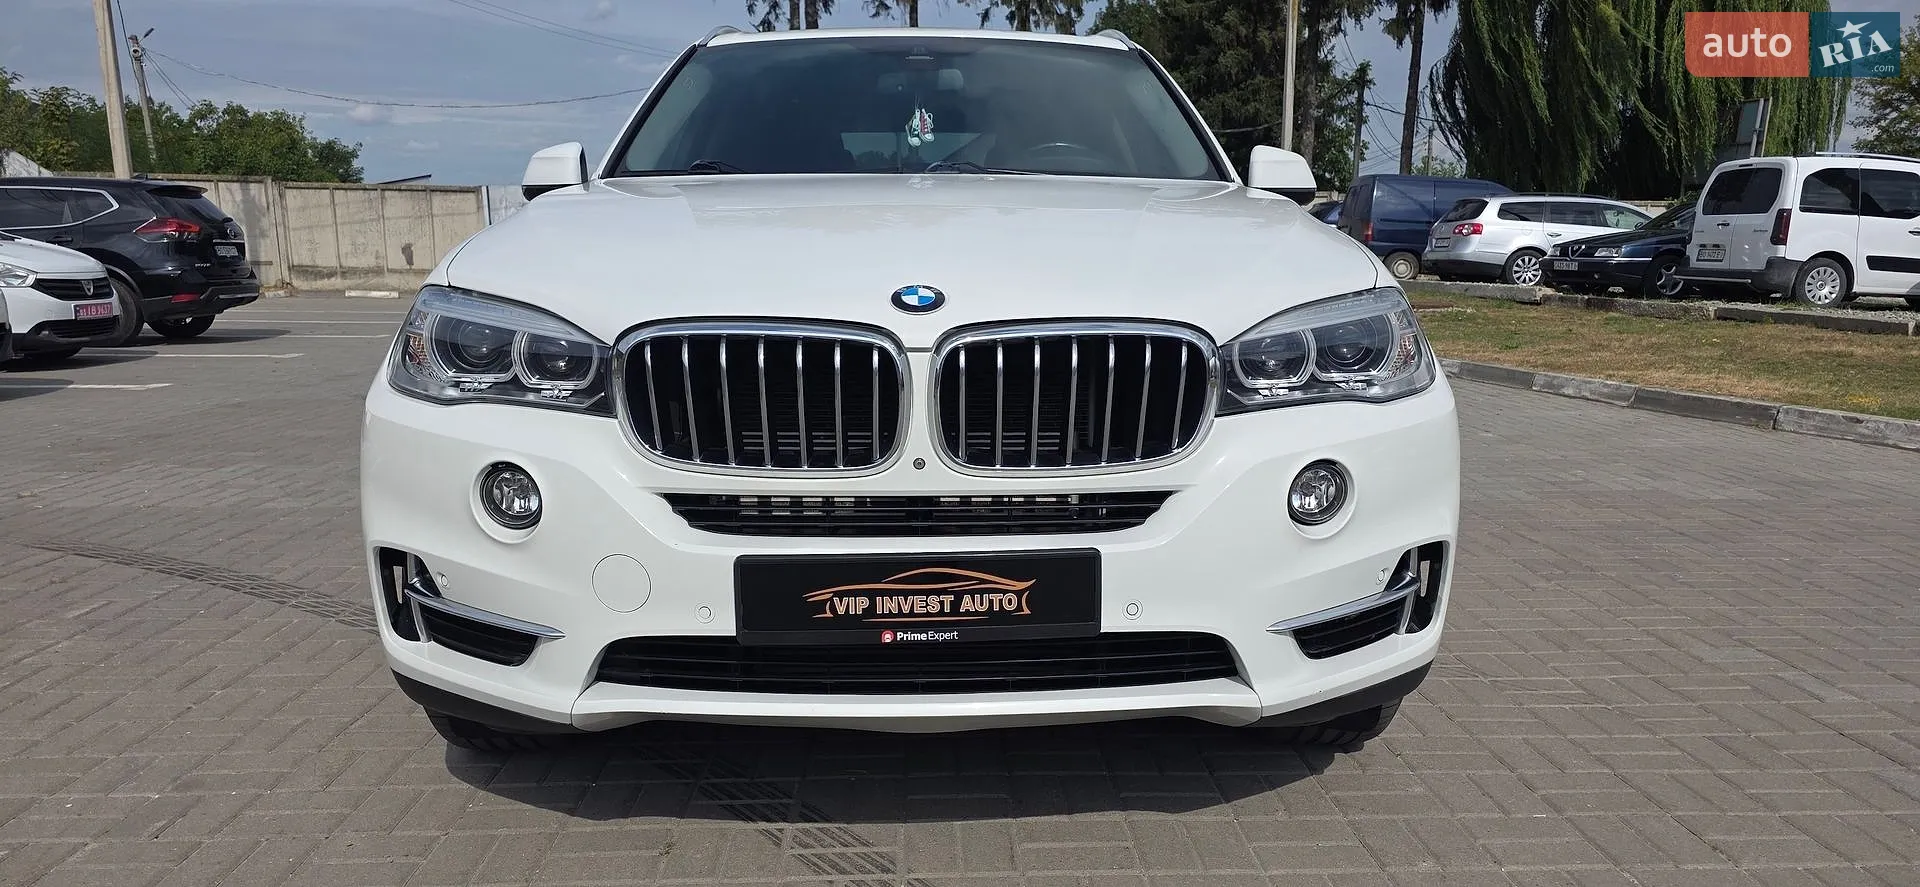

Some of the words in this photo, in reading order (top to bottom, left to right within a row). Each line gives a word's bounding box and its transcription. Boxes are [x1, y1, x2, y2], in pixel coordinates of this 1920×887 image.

[833, 597, 869, 614] VIP
[876, 595, 954, 613] INVEST
[960, 593, 1018, 612] AUTO
